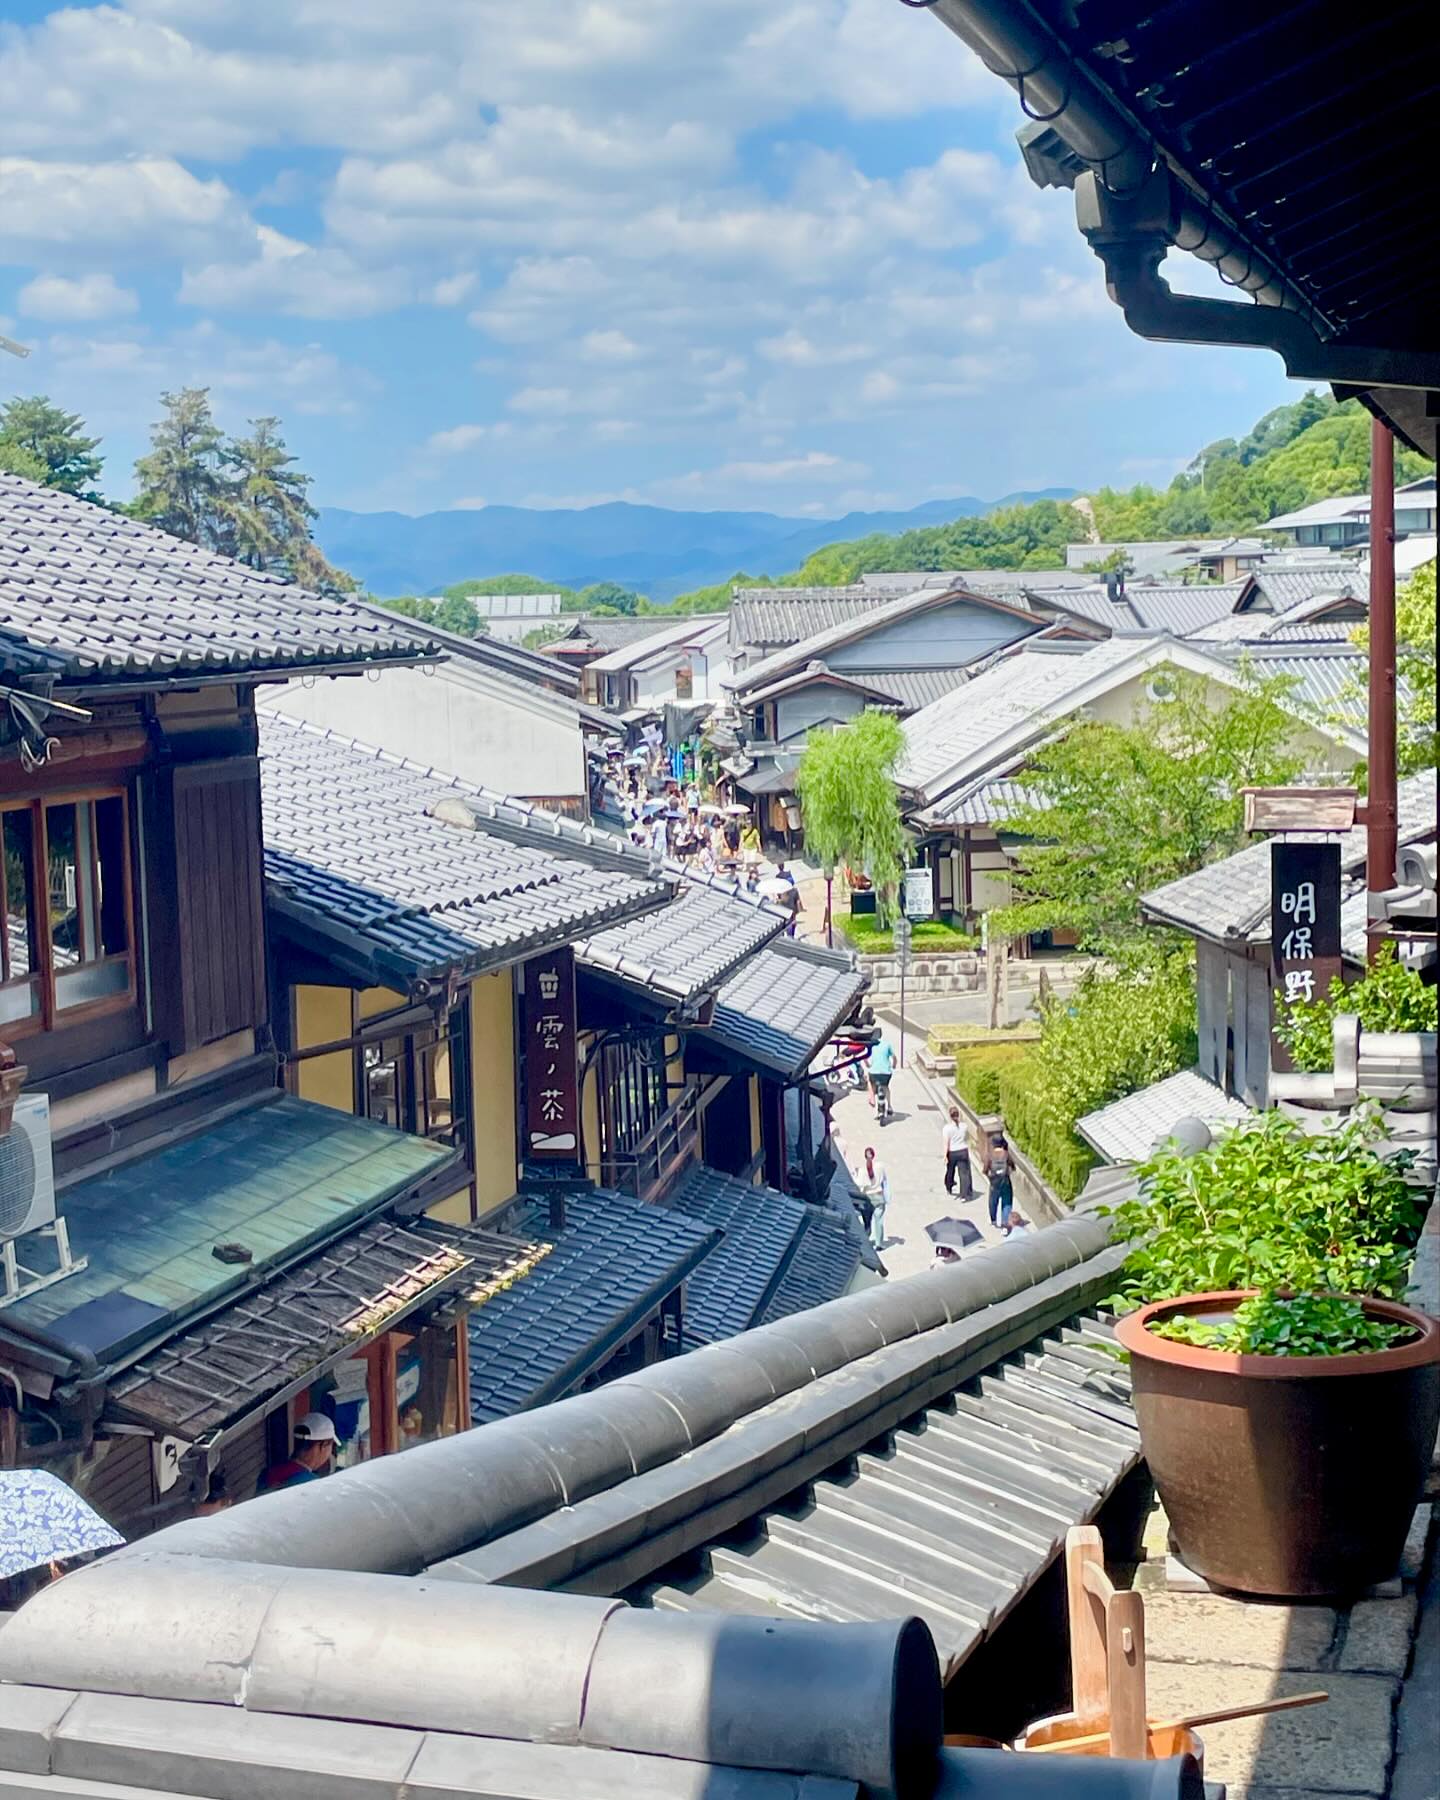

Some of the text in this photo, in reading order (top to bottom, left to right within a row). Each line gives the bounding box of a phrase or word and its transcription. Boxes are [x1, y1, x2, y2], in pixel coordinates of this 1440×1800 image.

[1281, 882, 1316, 1003] 明保野
[536, 1015, 564, 1121] 雲ノ茶
